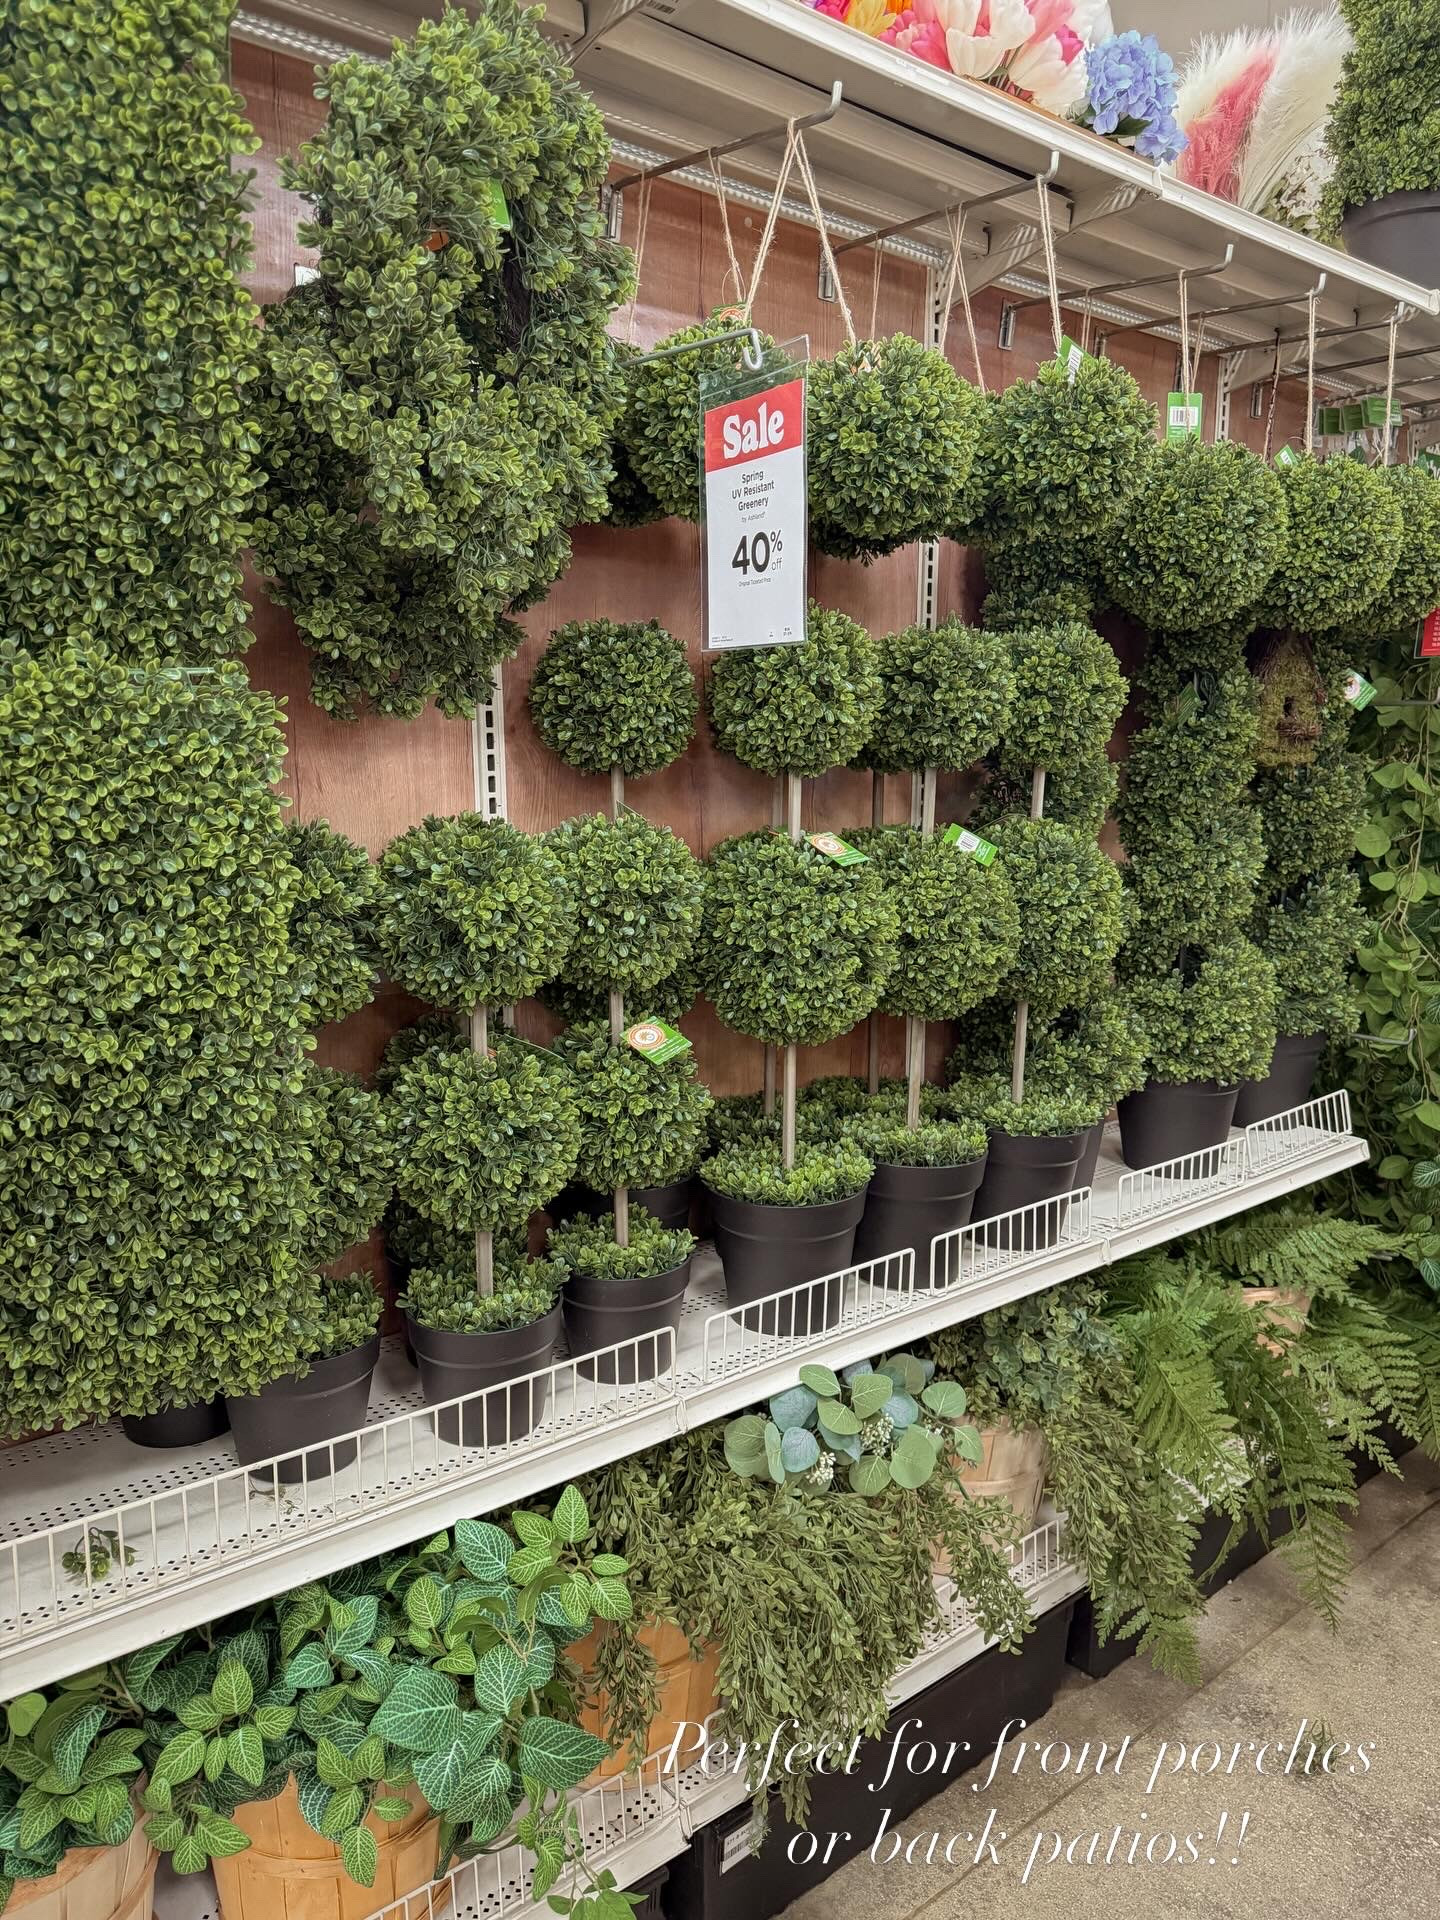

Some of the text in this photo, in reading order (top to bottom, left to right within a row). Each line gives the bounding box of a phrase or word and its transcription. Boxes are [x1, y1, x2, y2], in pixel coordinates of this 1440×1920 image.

[722, 401, 785, 460] Sale
[741, 470, 764, 485] Spring
[731, 479, 775, 500] UV Resistant
[737, 496, 769, 511] Greenery
[771, 557, 783, 571] off
